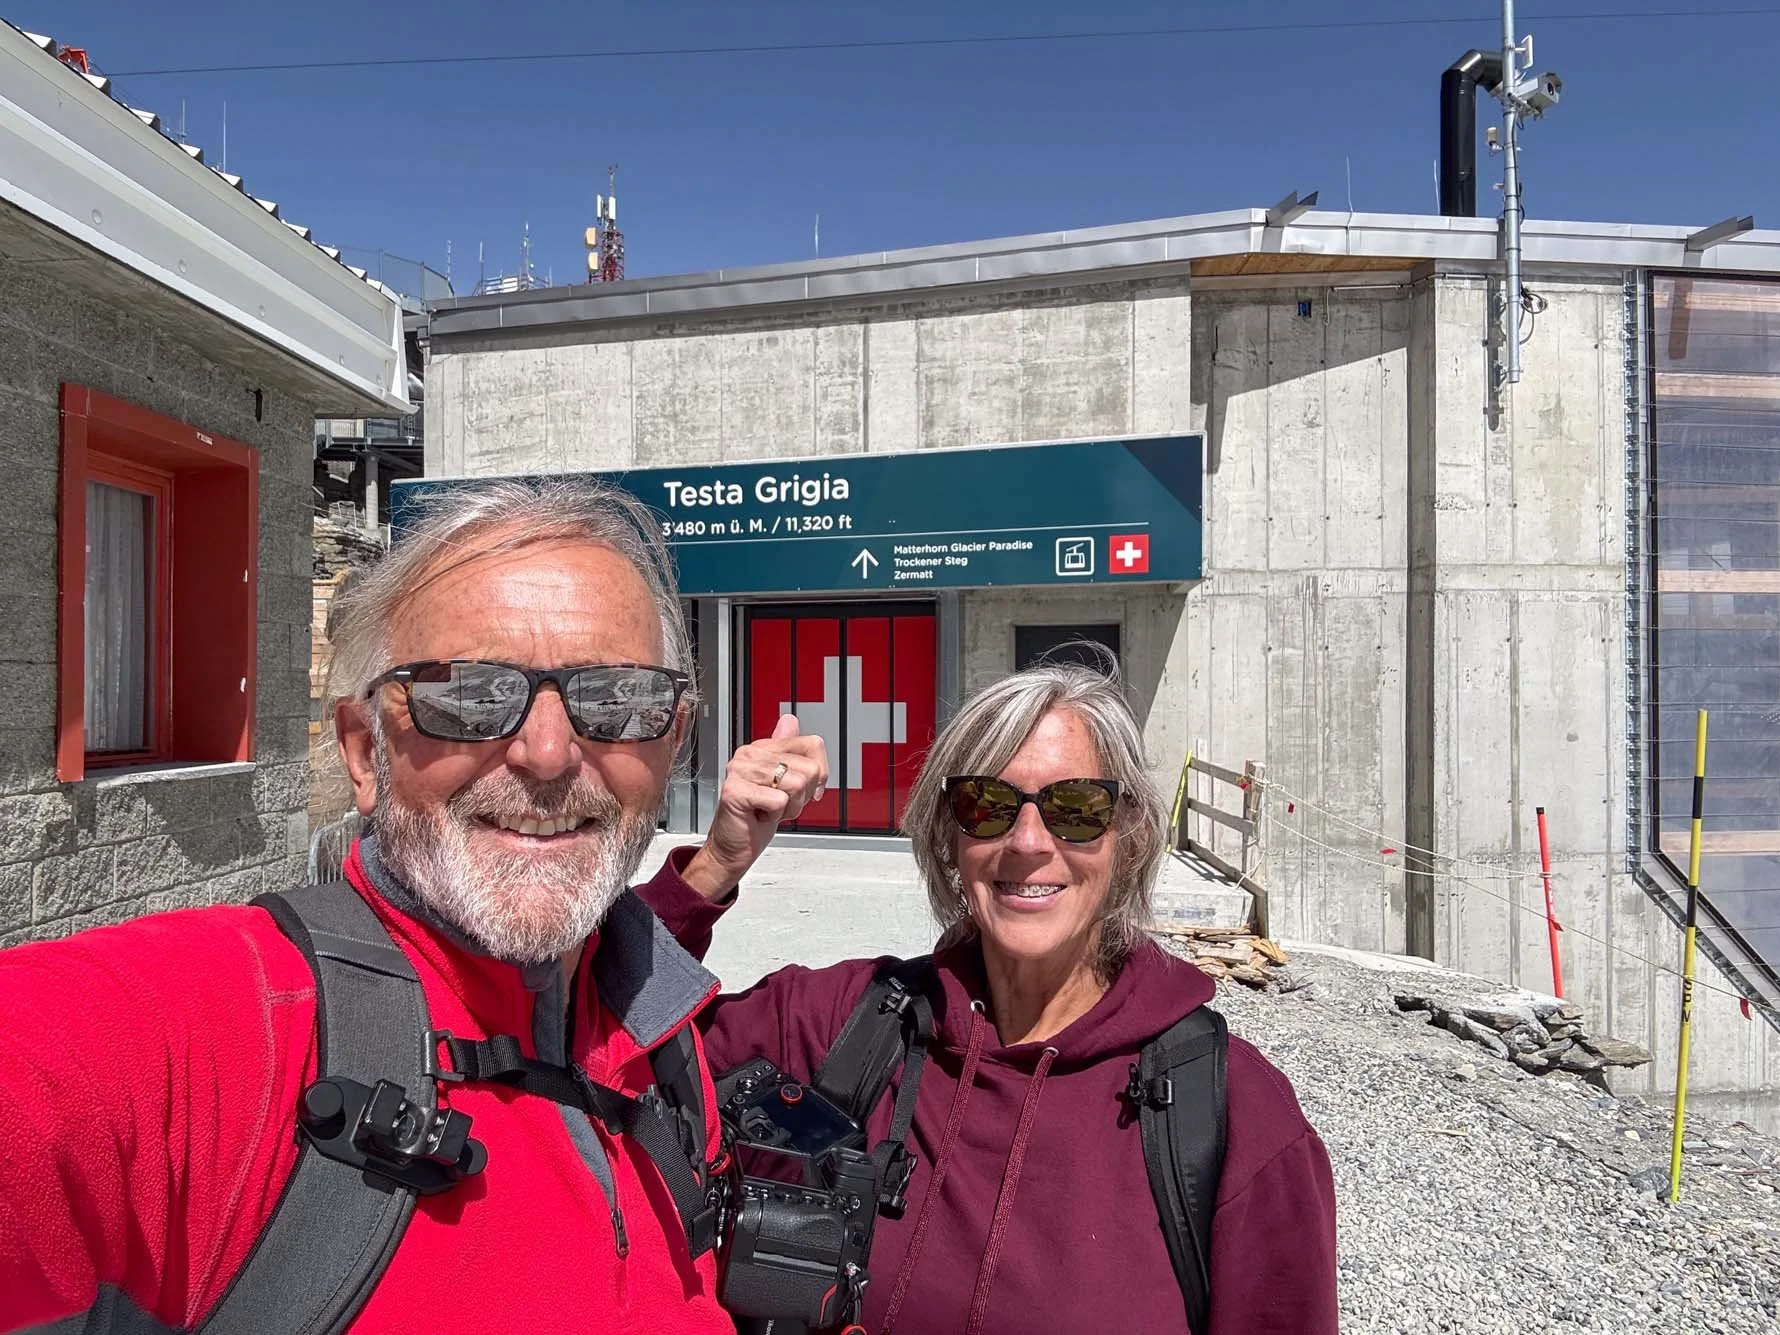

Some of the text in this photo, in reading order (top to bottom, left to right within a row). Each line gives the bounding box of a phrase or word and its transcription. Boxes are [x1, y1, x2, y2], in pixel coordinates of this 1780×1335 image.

[663, 472, 850, 507] Testa Grigia
[711, 523, 725, 535] m
[730, 519, 744, 534] ü.
[749, 518, 767, 533] M.
[771, 516, 781, 534] /
[786, 515, 834, 534] 11,320
[838, 514, 852, 529] ft
[894, 540, 1033, 555] Matterhorn Glacier Paradise
[894, 555, 969, 567] Trockener Steg
[894, 569, 934, 580] Zermatt
